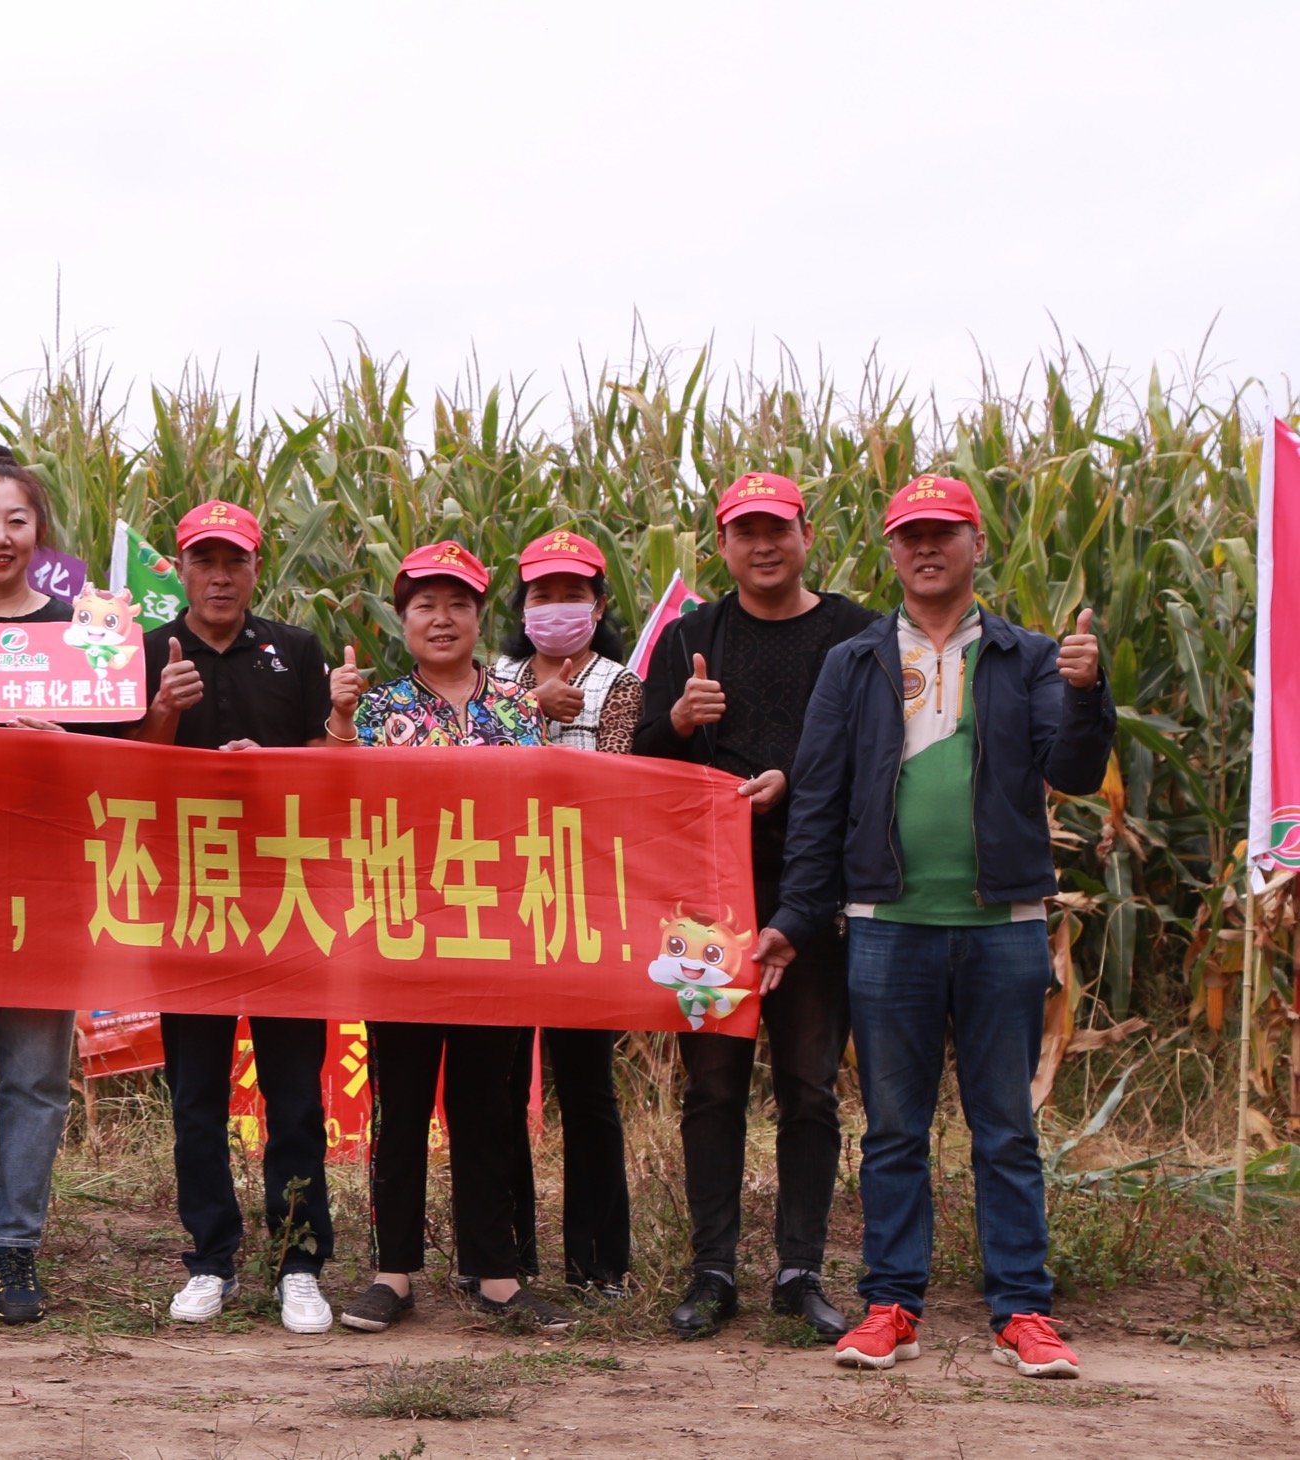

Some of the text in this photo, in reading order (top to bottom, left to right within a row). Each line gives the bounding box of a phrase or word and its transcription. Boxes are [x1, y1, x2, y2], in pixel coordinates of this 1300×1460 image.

[737, 485, 777, 499] 中源农业
[906, 489, 947, 503] 中源农业
[200, 515, 238, 527] 中源农业
[543, 541, 579, 554] 中源农业
